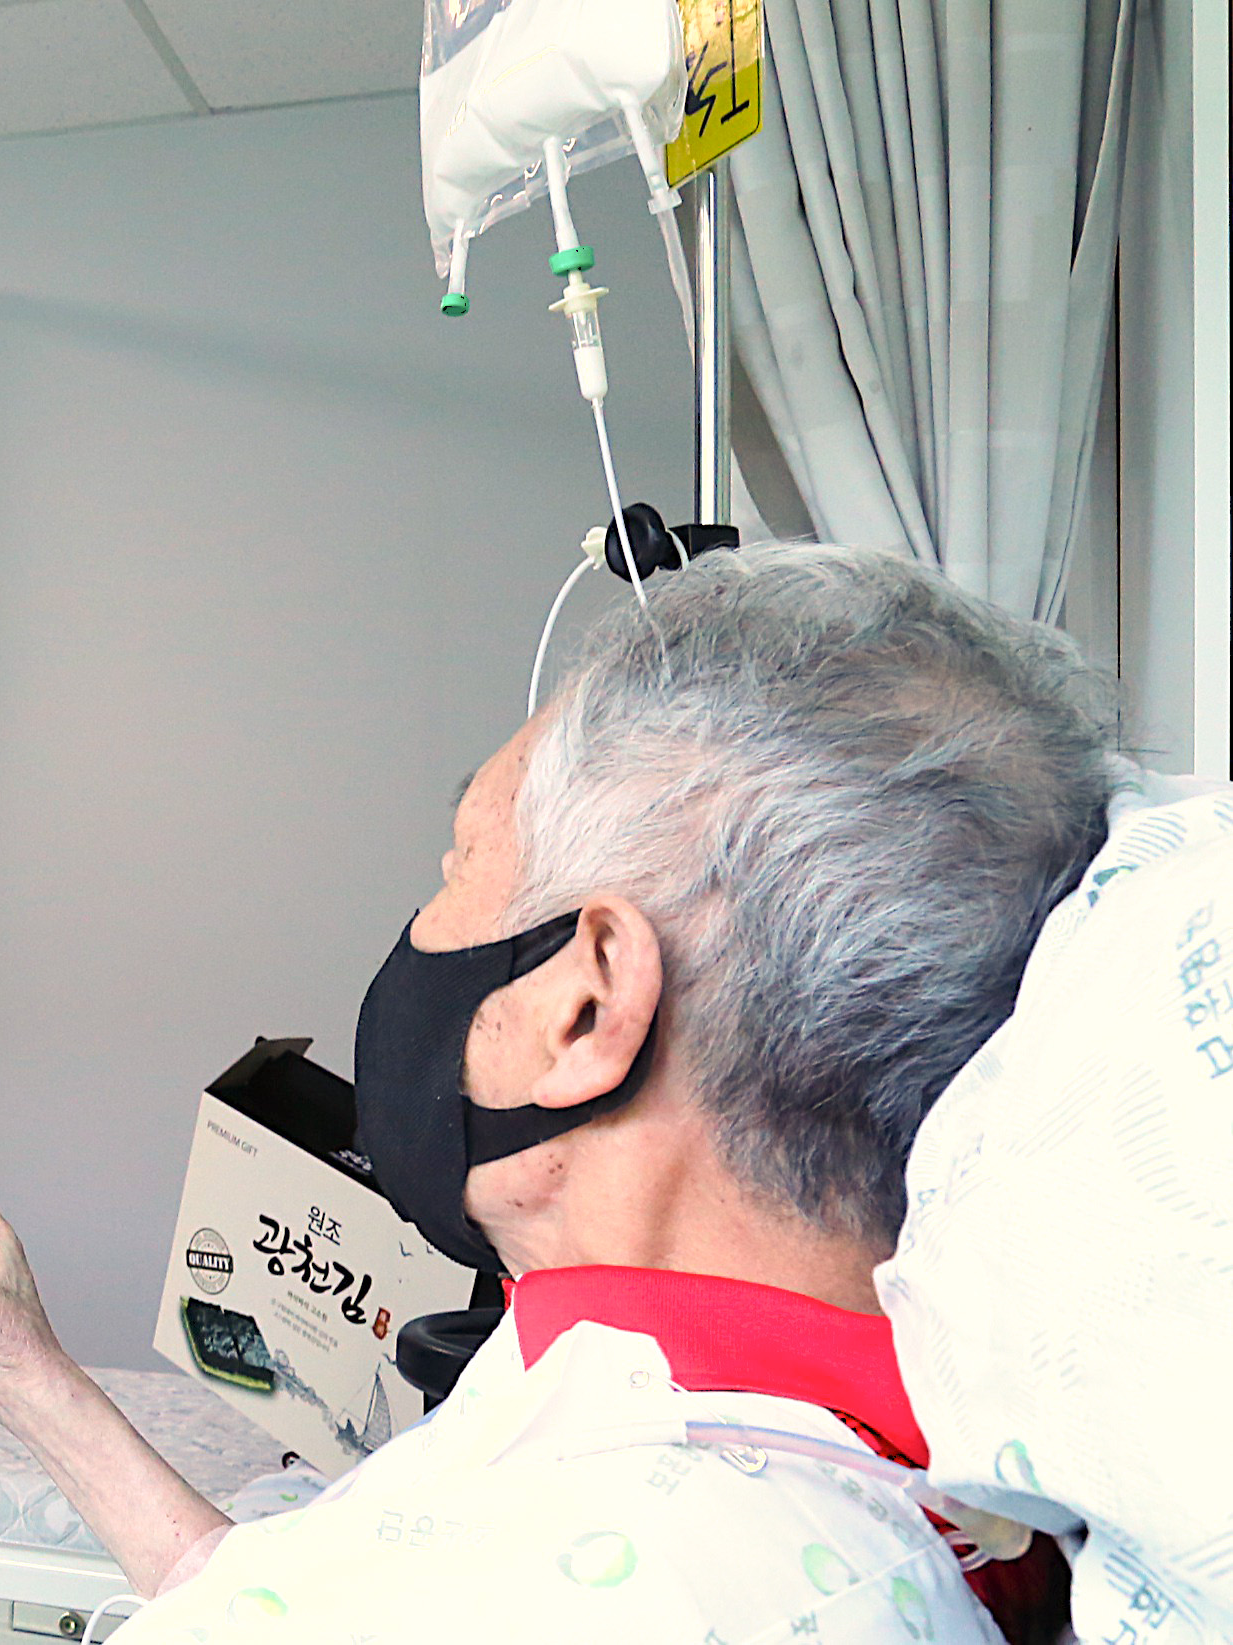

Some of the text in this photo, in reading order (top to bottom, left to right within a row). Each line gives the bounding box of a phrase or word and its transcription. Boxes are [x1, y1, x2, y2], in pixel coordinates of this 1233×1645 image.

[307, 1206, 342, 1246] 원조
[189, 1253, 229, 1270] QUALITY
[253, 1214, 372, 1325] 광천김
